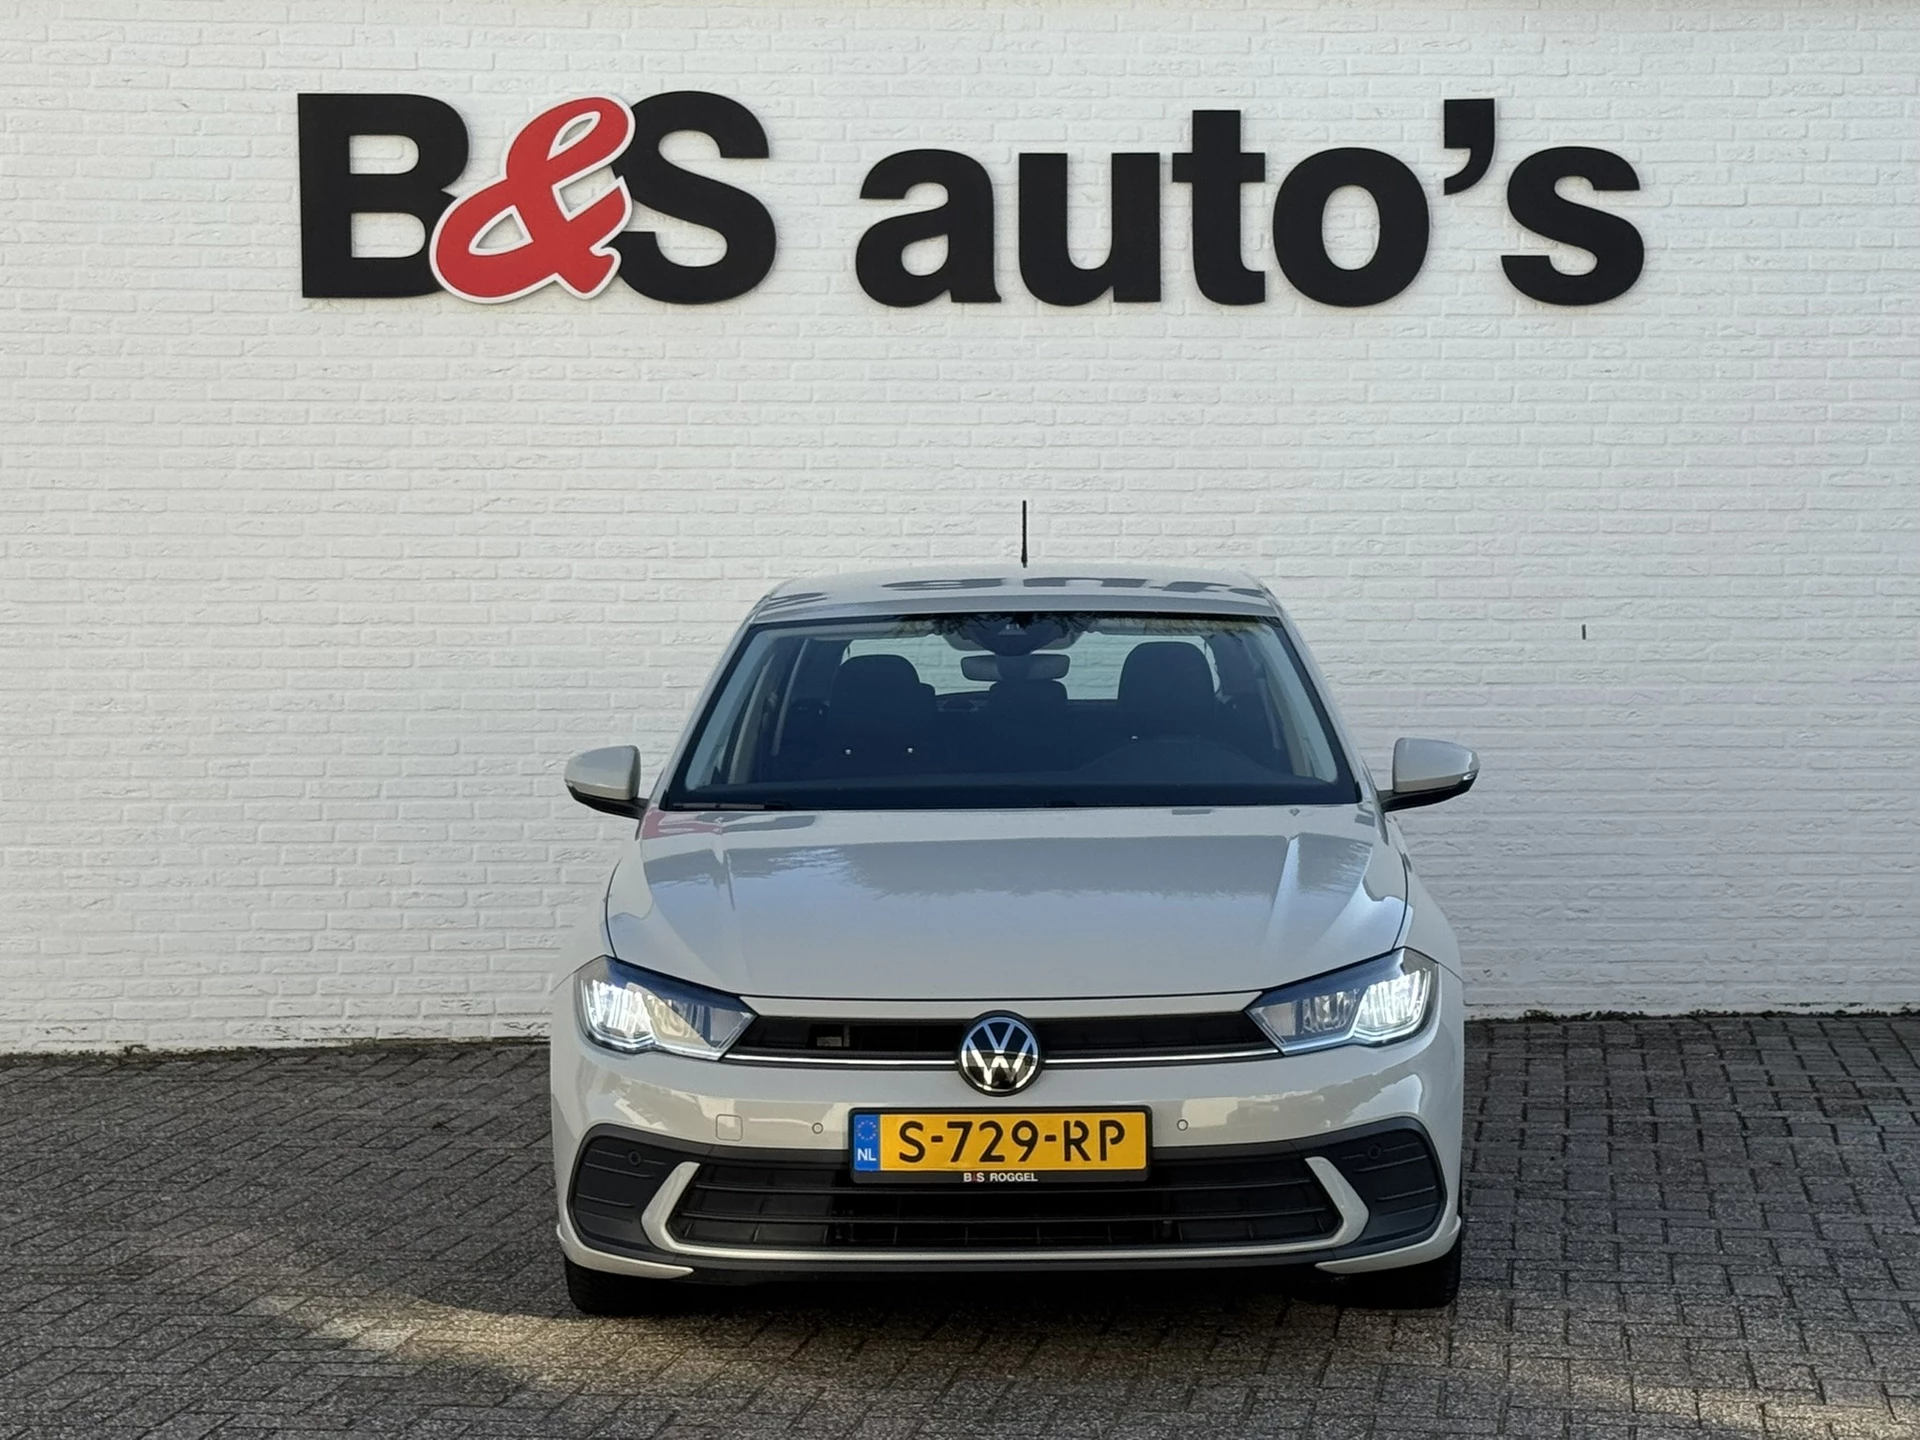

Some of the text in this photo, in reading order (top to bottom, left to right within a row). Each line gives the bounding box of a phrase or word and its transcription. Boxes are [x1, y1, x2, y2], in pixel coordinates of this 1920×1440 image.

[298, 91, 1644, 306] B&S auto's
[857, 1120, 1125, 1163] NL S-729-RP
[989, 1172, 1038, 1182] ROGGEL
